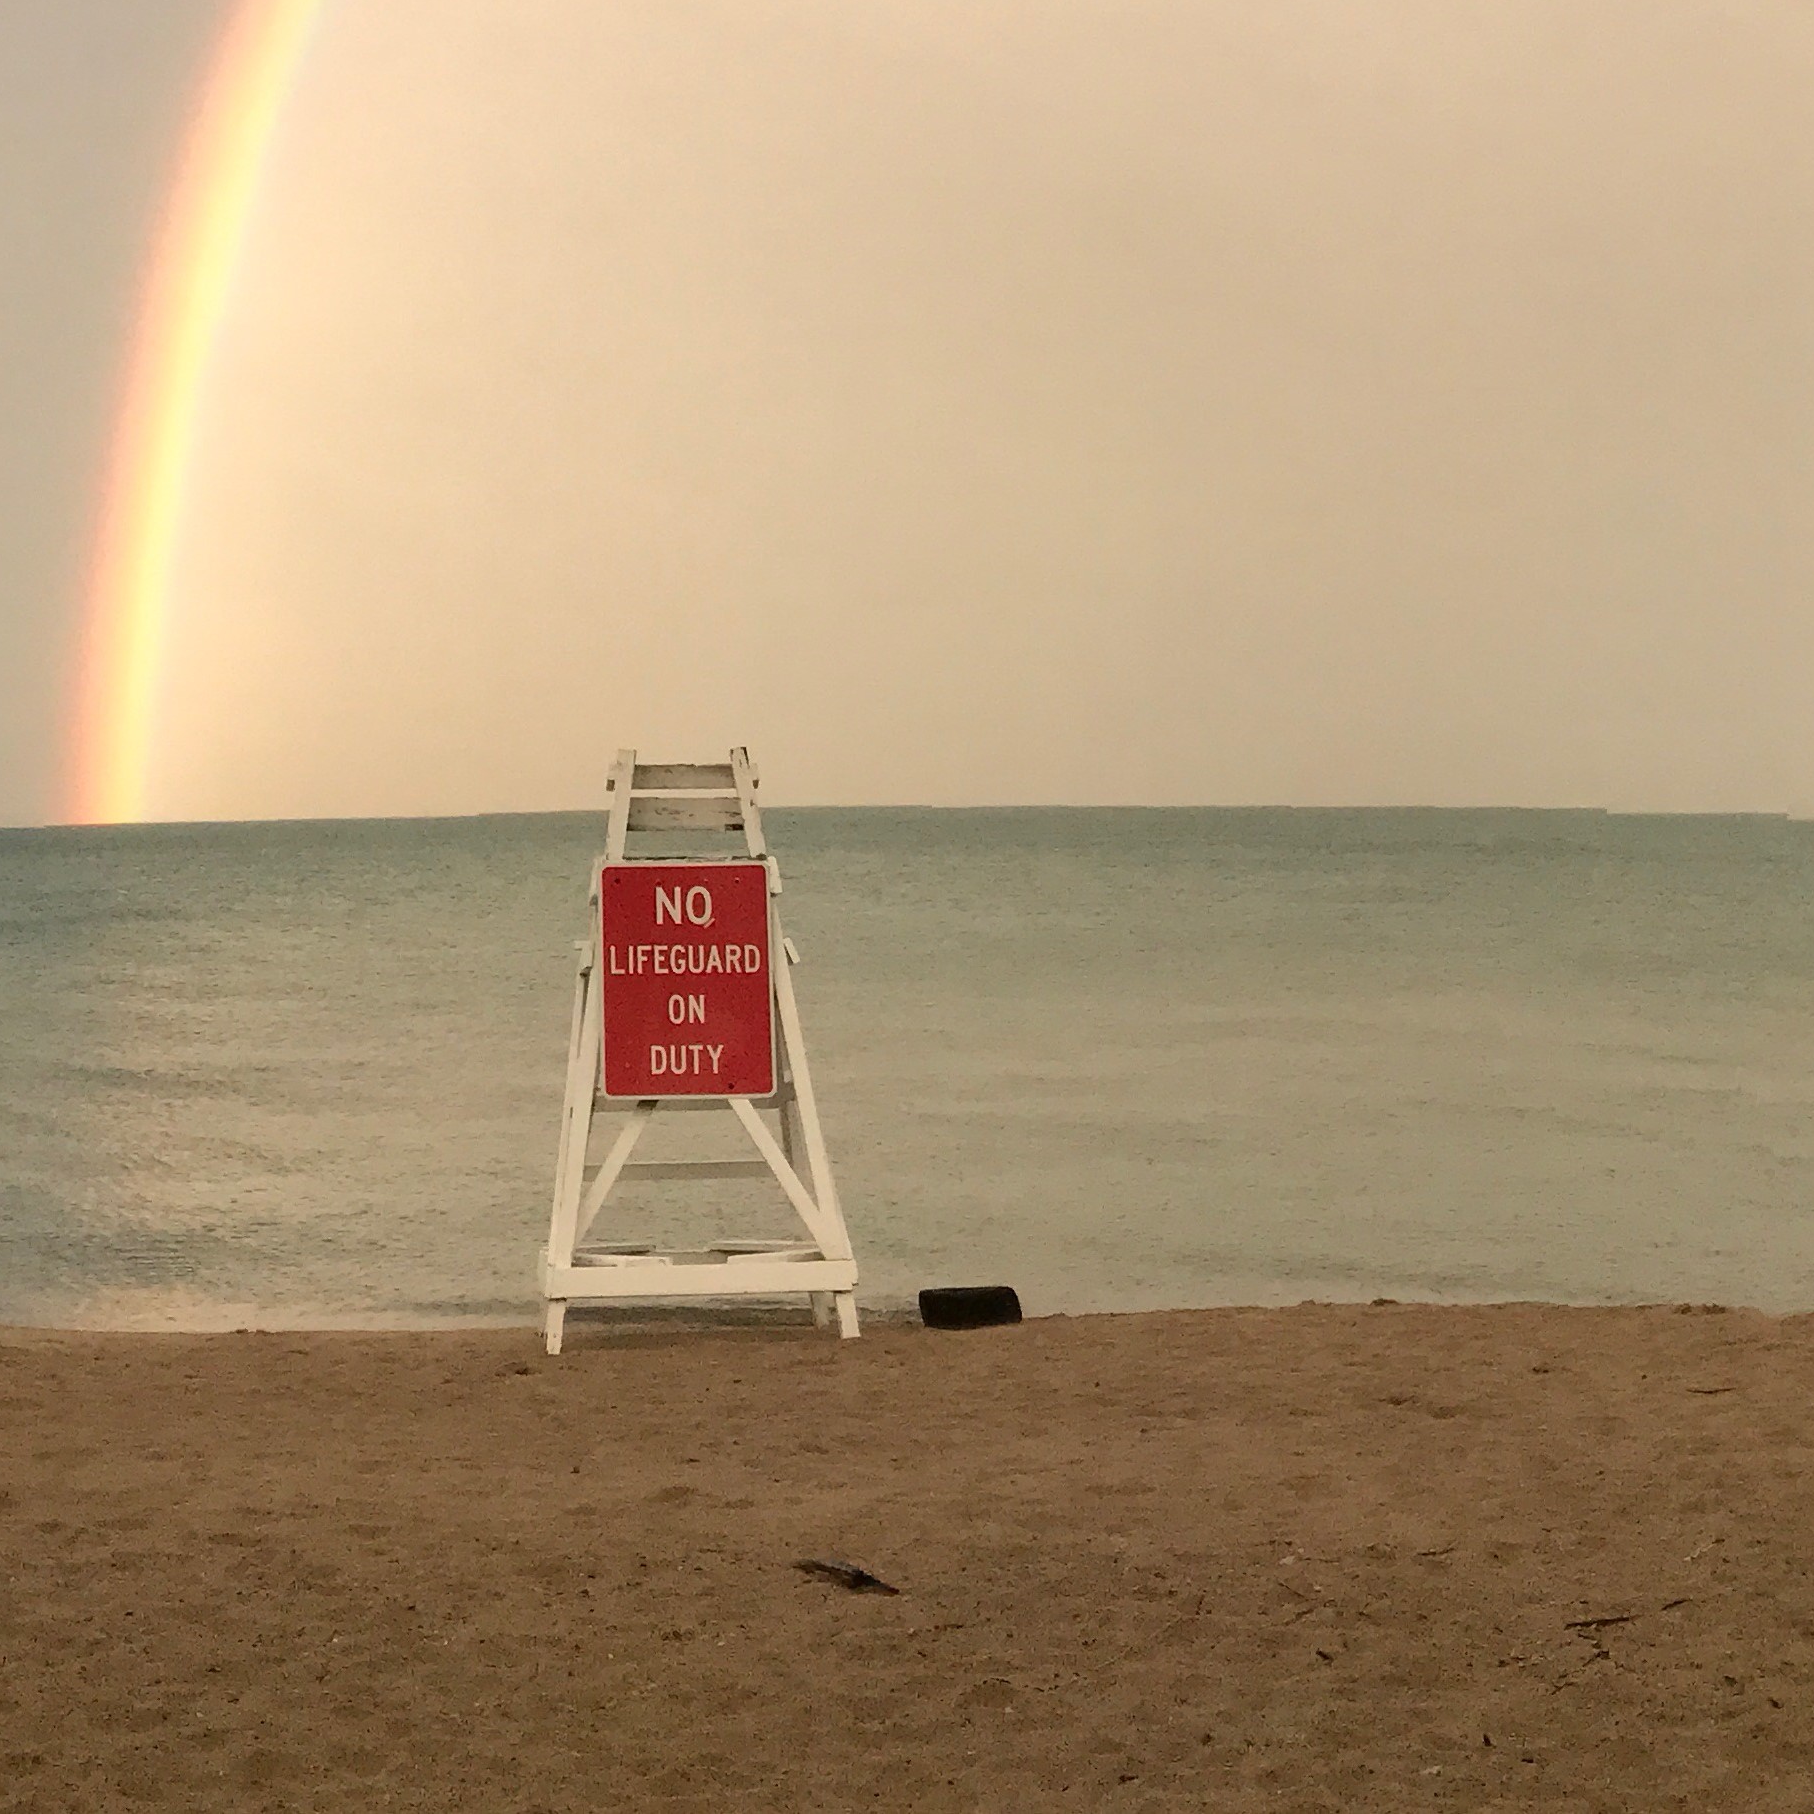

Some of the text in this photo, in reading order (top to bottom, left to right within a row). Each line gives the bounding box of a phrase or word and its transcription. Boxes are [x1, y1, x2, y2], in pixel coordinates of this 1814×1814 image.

[655, 886, 715, 927] NO
[610, 944, 761, 975] LIFEGUARD
[668, 994, 705, 1024] ON
[650, 1045, 724, 1075] DUTY
